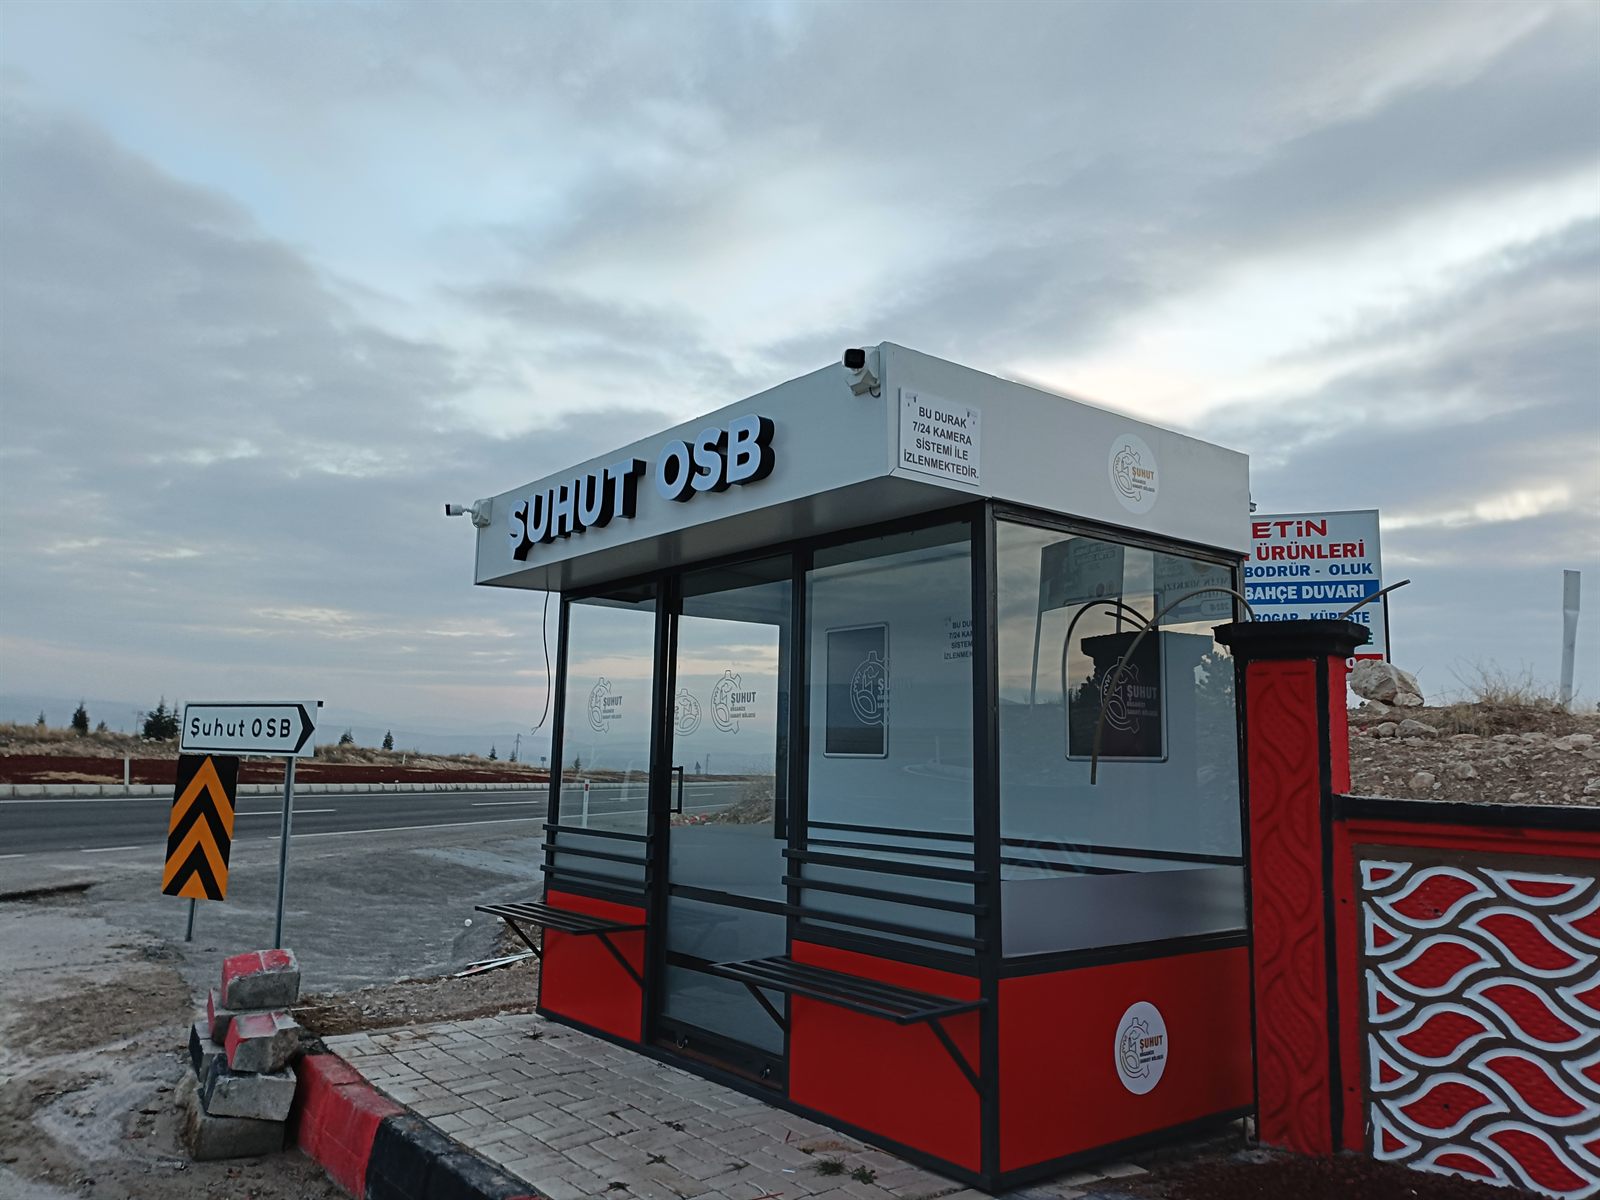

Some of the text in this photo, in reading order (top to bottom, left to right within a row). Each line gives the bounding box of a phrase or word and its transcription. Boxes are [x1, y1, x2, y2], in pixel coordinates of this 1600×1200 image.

[919, 406, 967, 429] BU DURAK
[913, 421, 973, 446] 7/24 KAMERA
[916, 437, 969, 460] SİSTEMİ İLE
[903, 449, 979, 479] İZLENMEKTEDİR.
[508, 414, 770, 558] ŞUHUT OSB
[1256, 539, 1365, 561] ÜRÜNLERİ
[1328, 562, 1373, 576] OLUK
[1244, 585, 1298, 603] BAHÇE
[1301, 584, 1365, 599] DUVARI
[730, 691, 757, 707] ŞUHUT
[190, 717, 291, 738] Şuhut OSB
